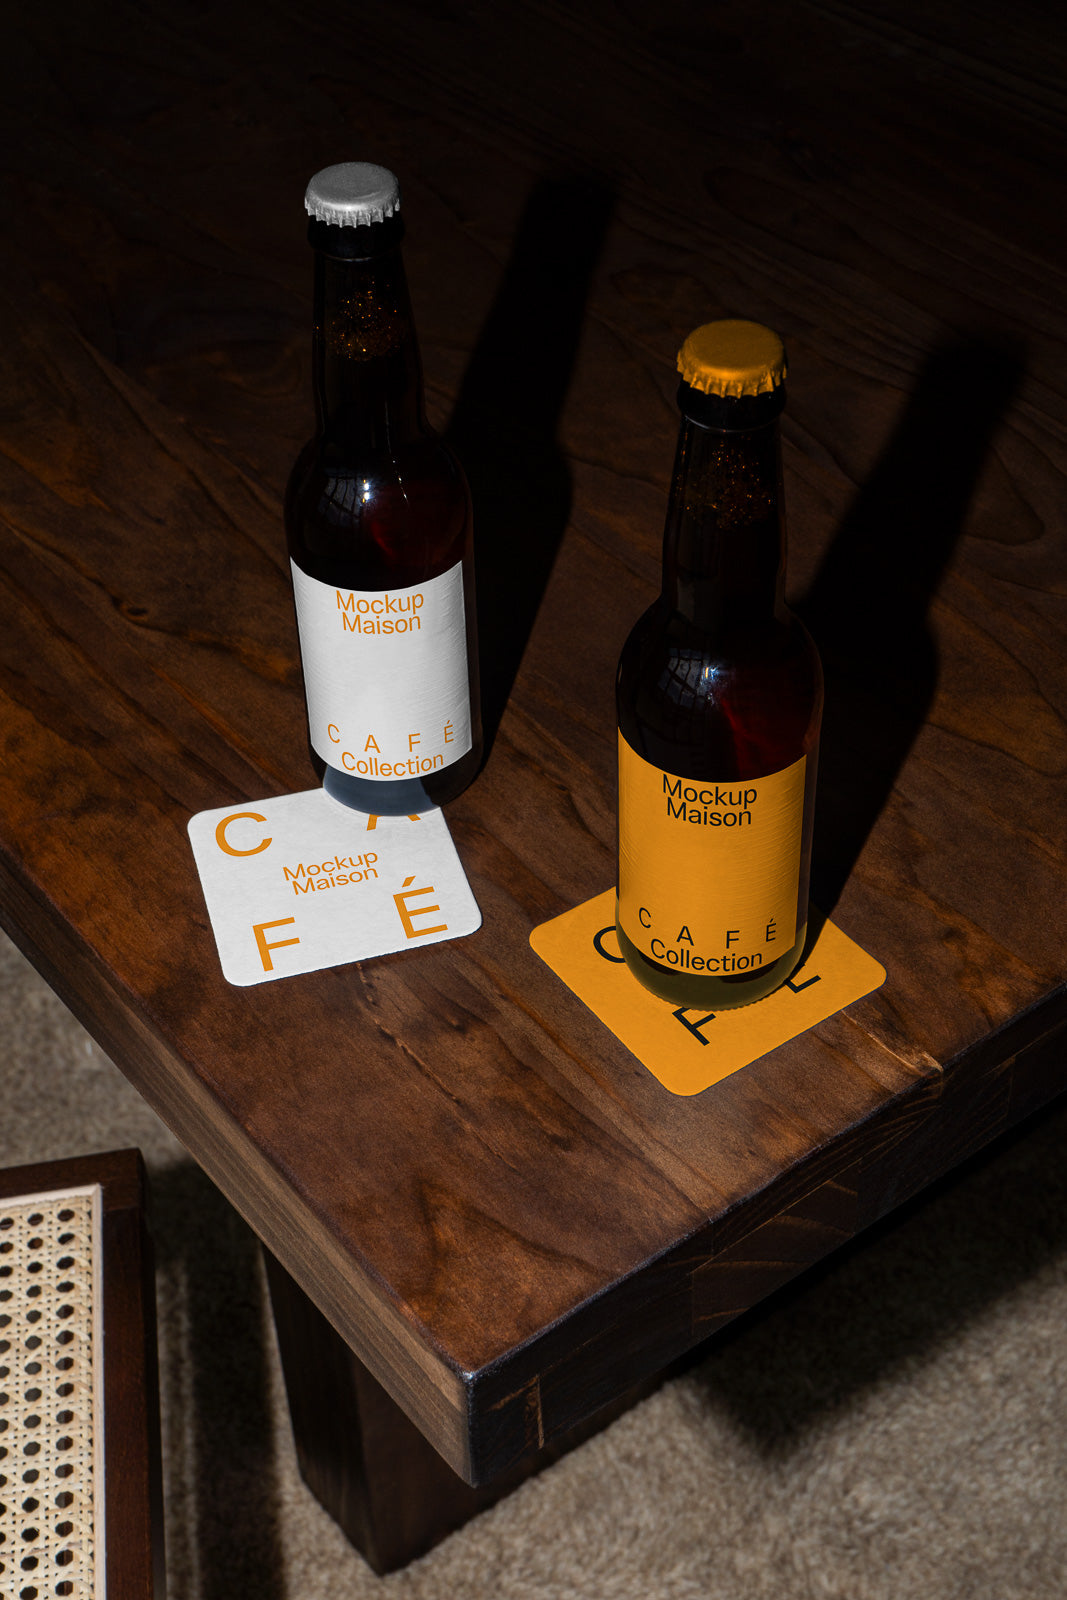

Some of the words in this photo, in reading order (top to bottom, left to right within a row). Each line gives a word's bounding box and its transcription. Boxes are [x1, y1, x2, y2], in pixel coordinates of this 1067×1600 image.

[336, 590, 424, 615] Mockup
[342, 612, 421, 634] Maison
[342, 752, 444, 776] Collection
[663, 774, 757, 810] Mockup
[667, 797, 752, 826] Maison
[283, 853, 379, 882] Mockup
[292, 867, 379, 895] Maison
[651, 939, 763, 973] Collection
